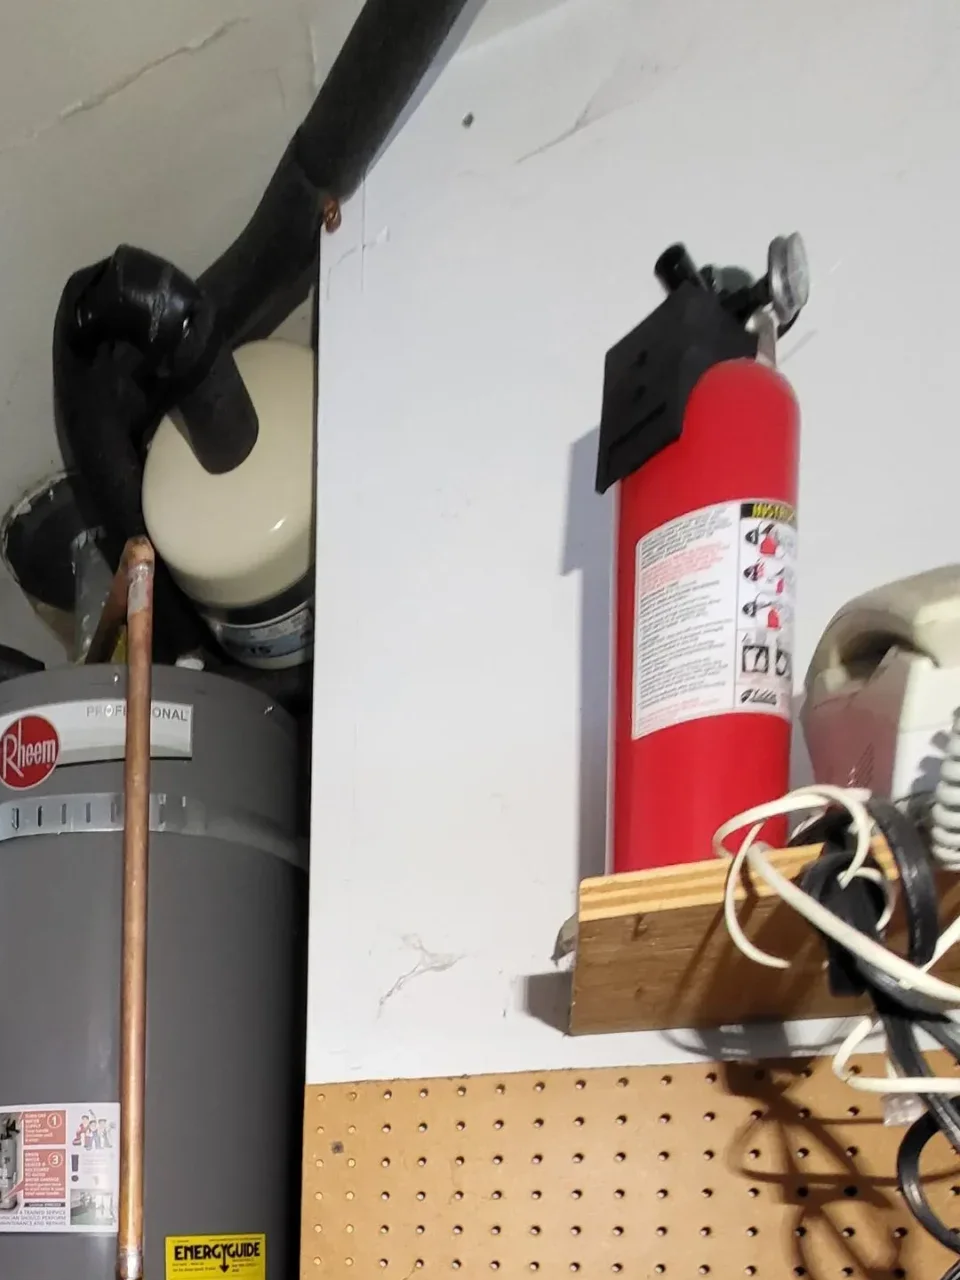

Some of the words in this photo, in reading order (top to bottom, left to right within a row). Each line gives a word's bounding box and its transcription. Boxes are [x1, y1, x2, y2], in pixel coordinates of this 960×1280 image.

[86, 705, 188, 721] PROFONAL
[3, 718, 56, 779] Rheem
[51, 1115, 57, 1126] 1
[51, 1154, 59, 1165] 3
[174, 1242, 260, 1260] ENERGYGUIDE
